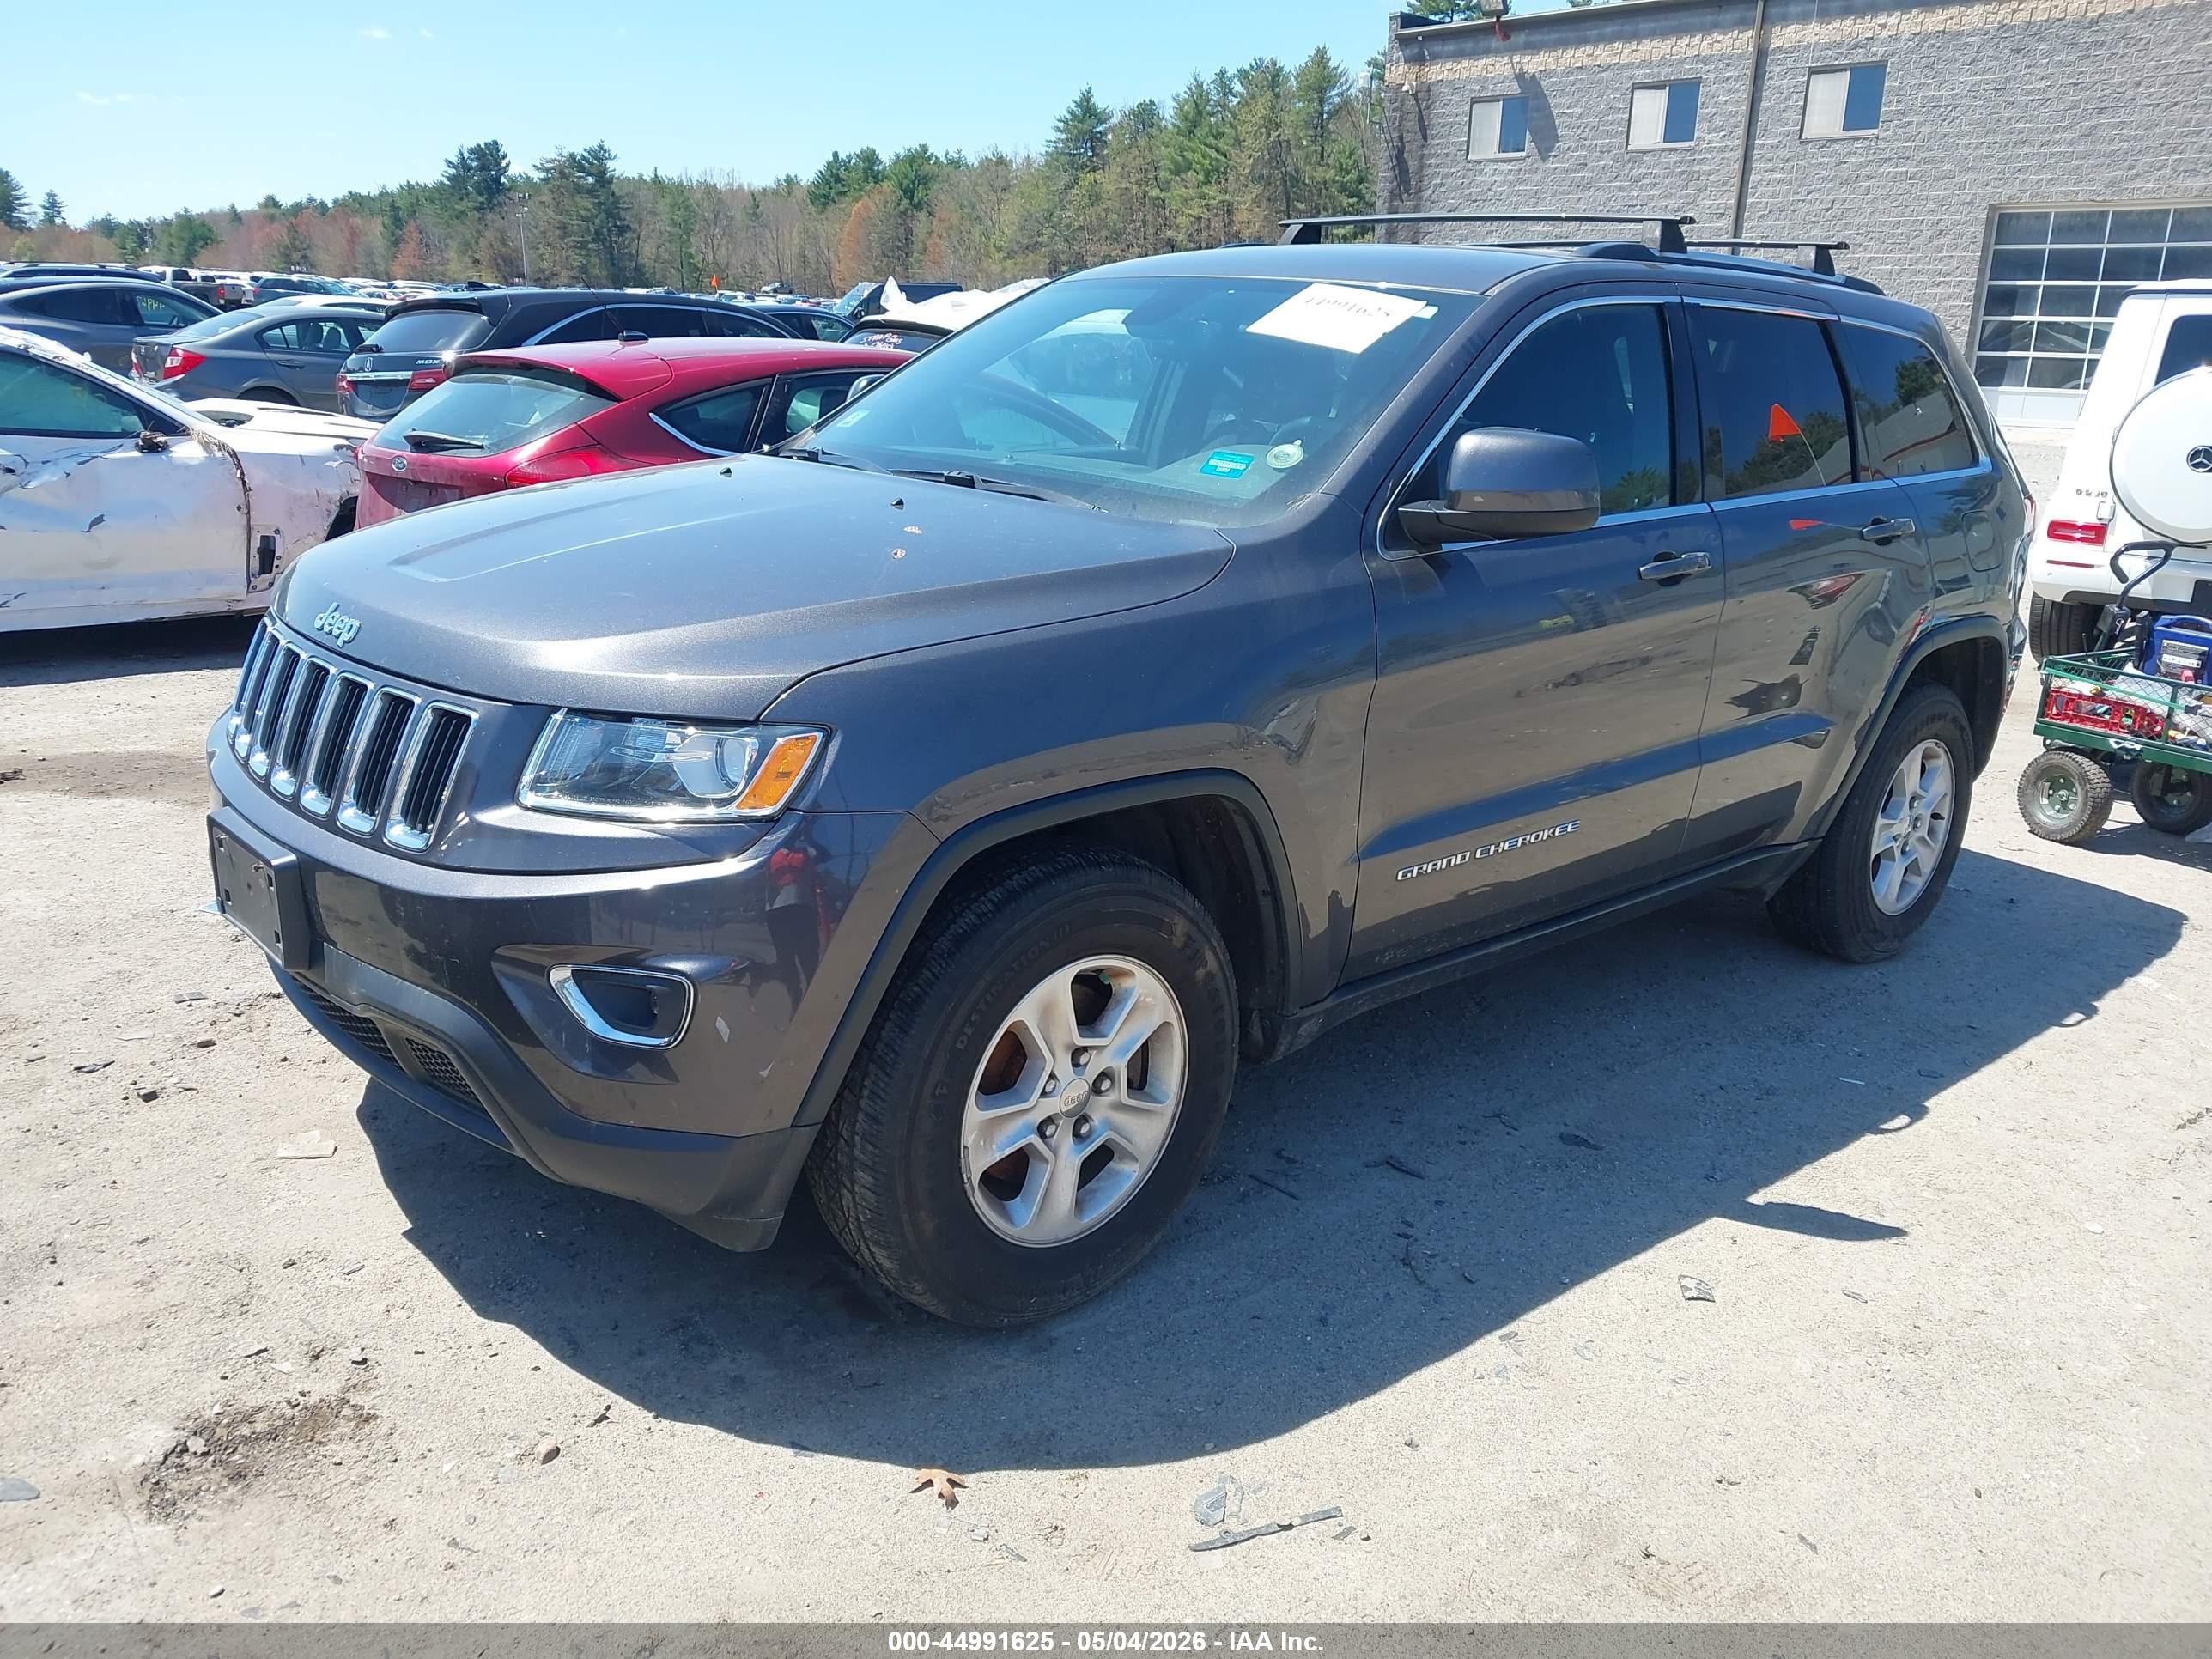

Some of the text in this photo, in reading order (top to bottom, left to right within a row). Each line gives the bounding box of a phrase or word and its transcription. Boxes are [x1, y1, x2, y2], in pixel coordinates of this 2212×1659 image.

[314, 601, 362, 648] Jeep
[1396, 819, 1581, 881] GRAND CHEROKEE
